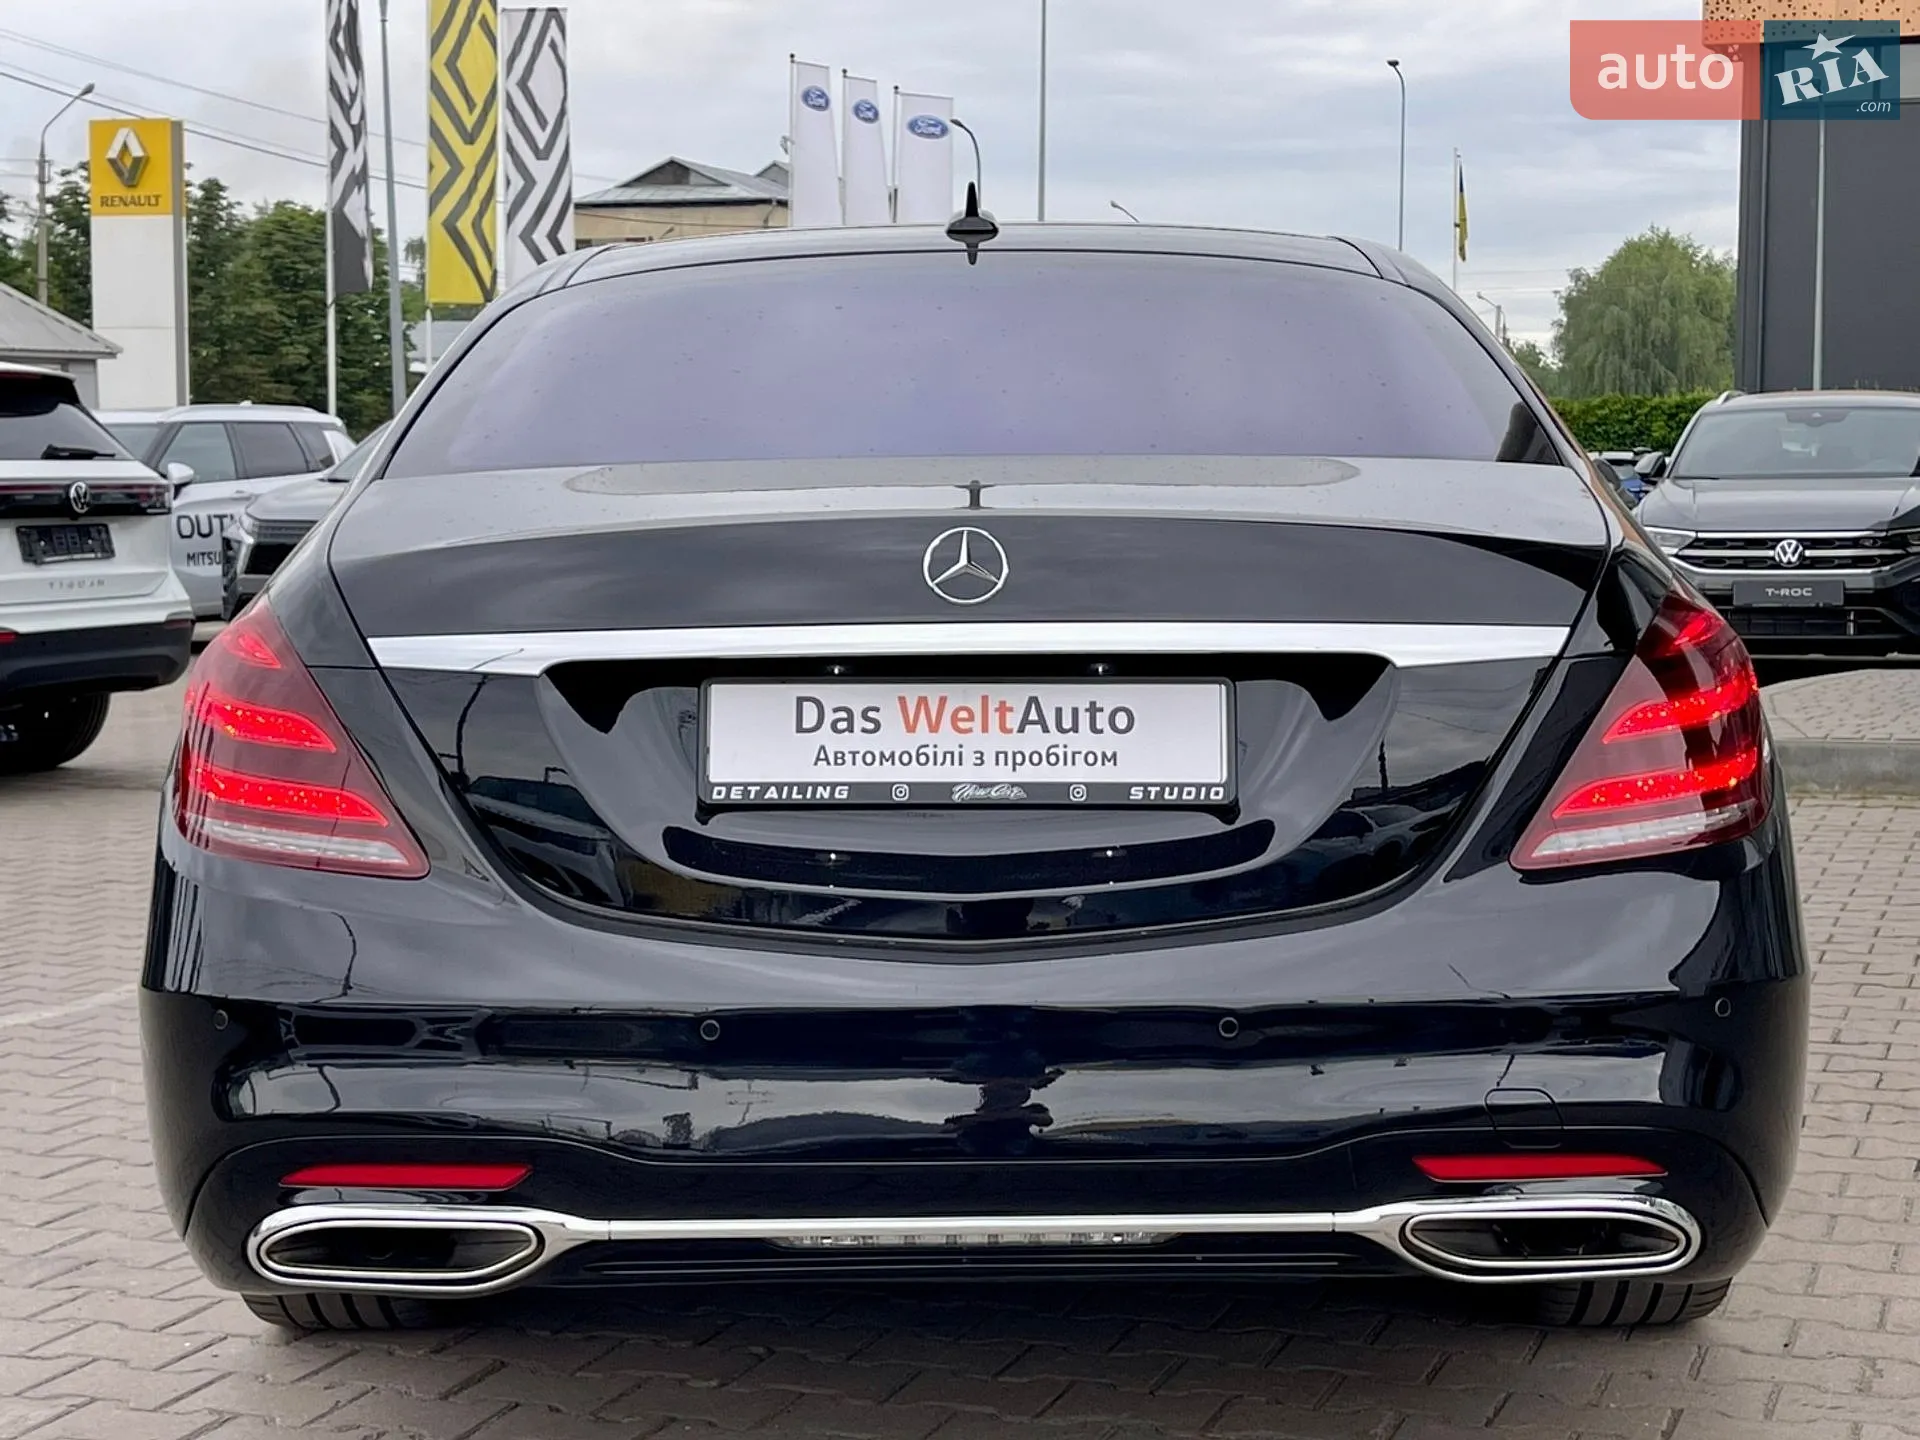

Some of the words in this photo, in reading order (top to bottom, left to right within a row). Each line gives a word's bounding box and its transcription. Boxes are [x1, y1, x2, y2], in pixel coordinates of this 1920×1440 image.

[99, 194, 162, 208] RENAULT
[1764, 587, 1813, 597] T-ROC
[795, 695, 882, 735] Das
[896, 694, 1136, 736] WeltAuto
[813, 743, 964, 768] Автомобілі
[972, 749, 986, 768] з
[994, 743, 1118, 773] пробігом
[711, 785, 850, 801] DETAILING
[1128, 786, 1225, 801] STUDIO
